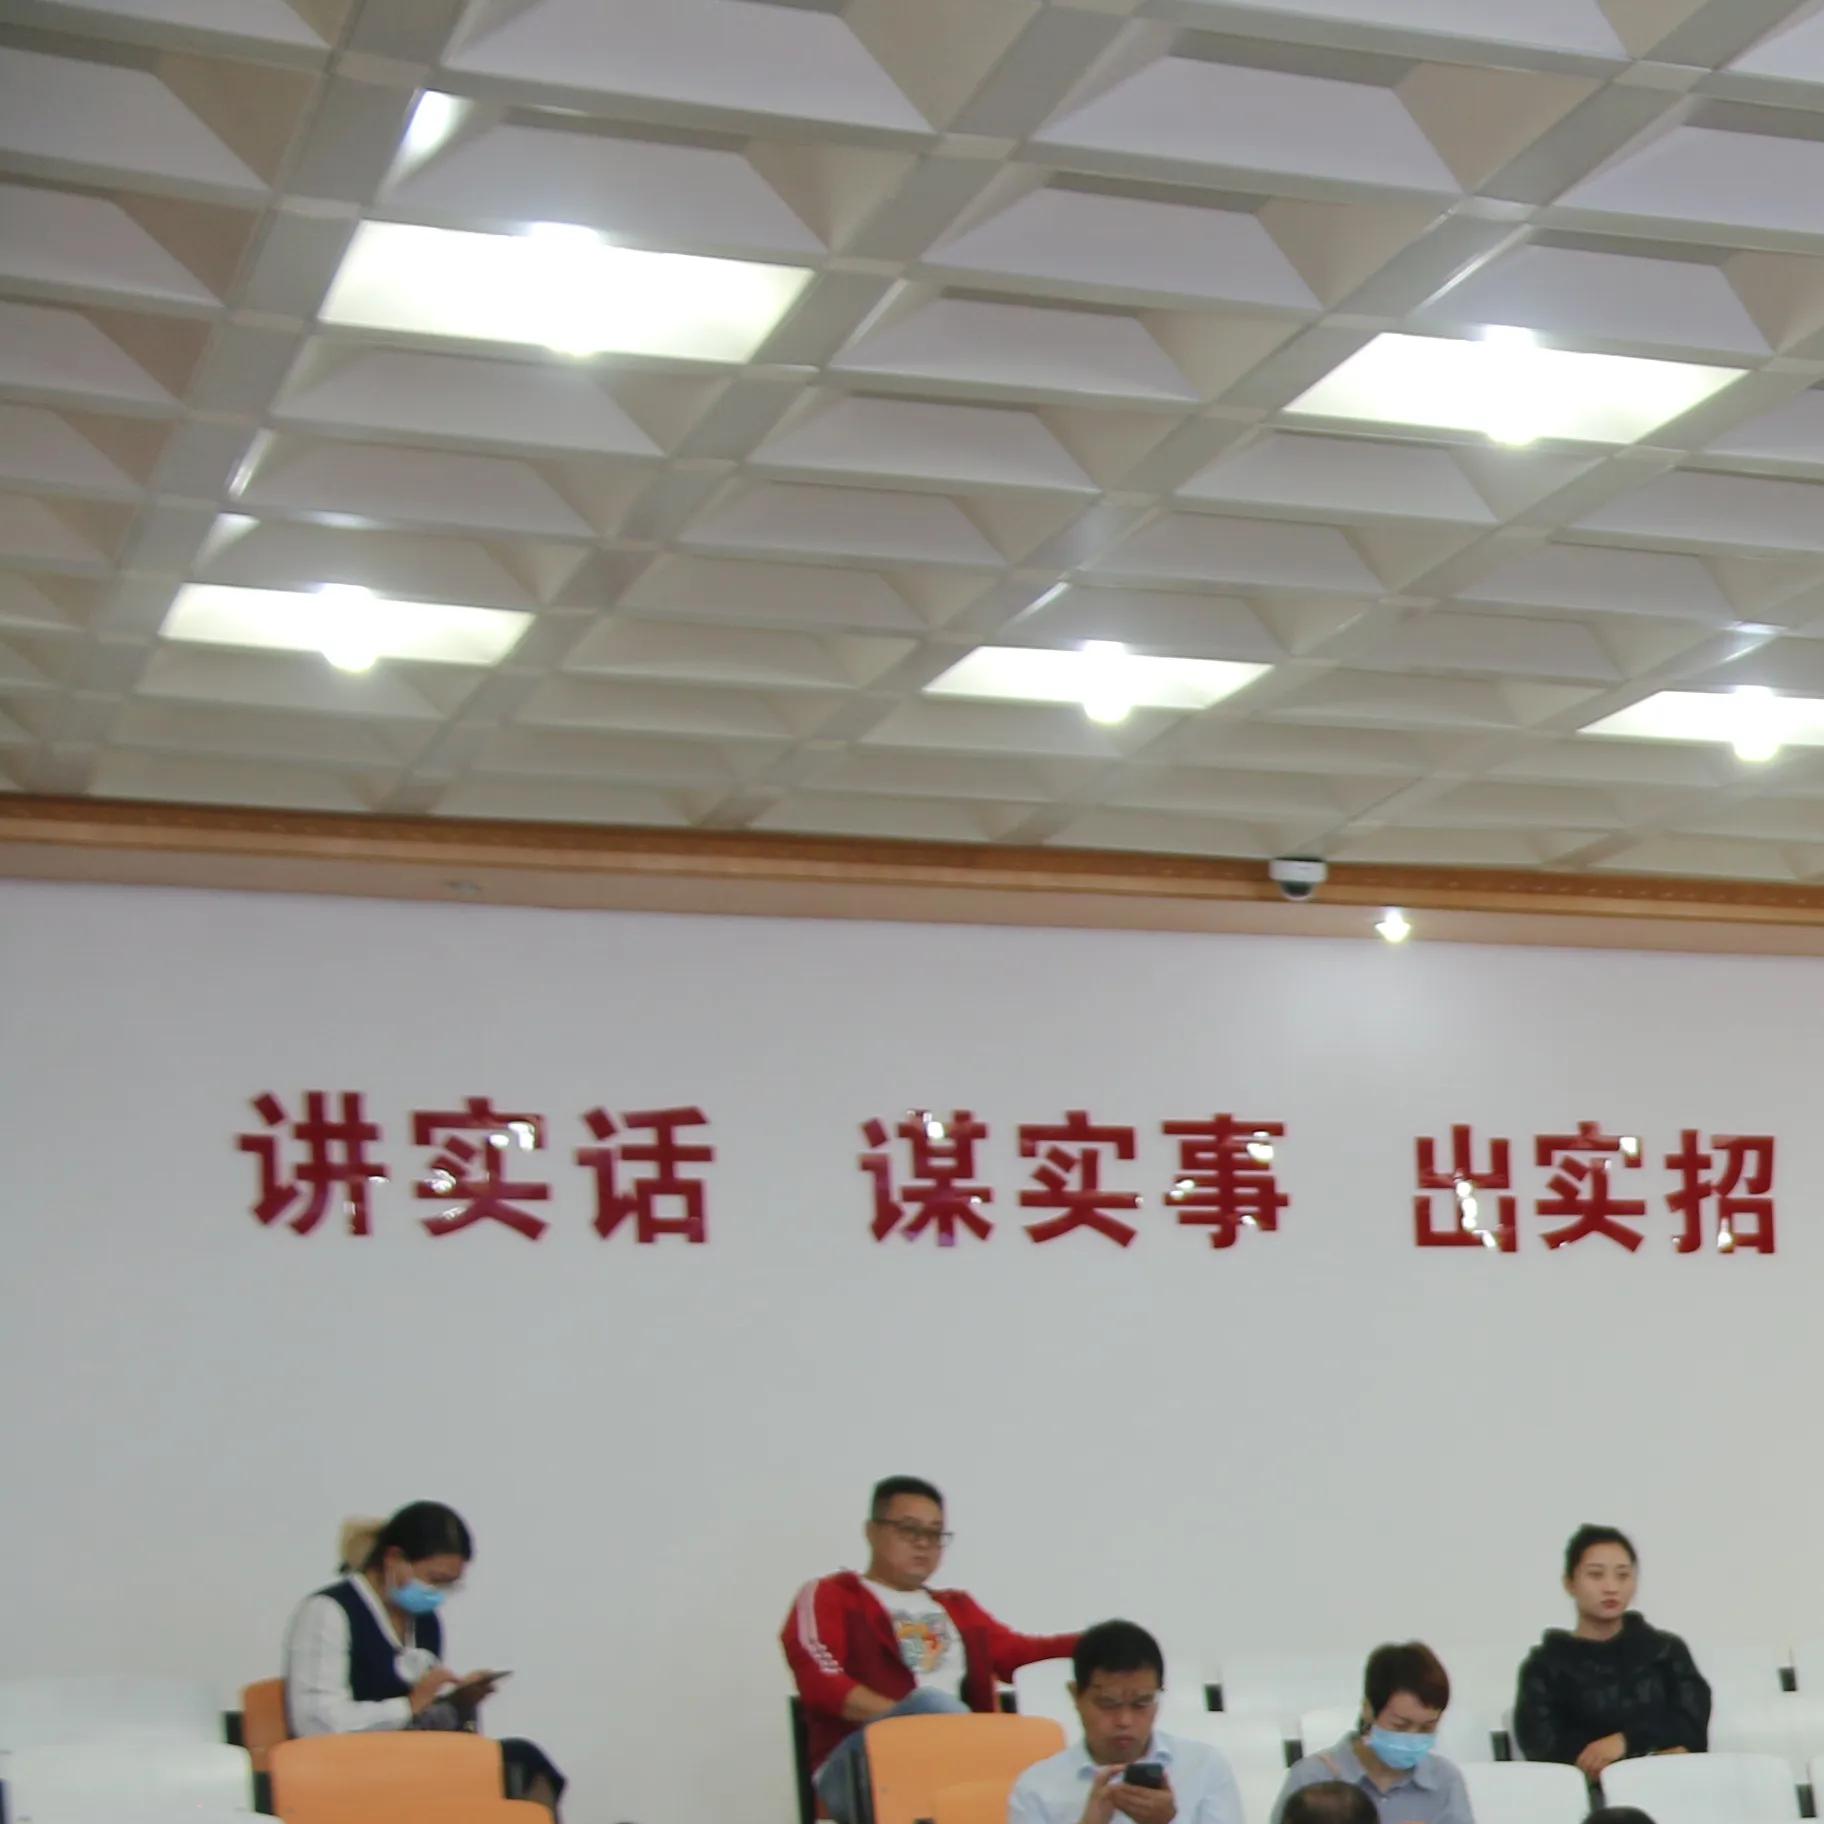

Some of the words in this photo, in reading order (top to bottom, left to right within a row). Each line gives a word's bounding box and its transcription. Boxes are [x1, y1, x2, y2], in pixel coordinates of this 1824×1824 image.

[238, 1092, 713, 1243] 讲实话
[860, 1110, 1290, 1248] 谋实事
[1414, 1121, 1777, 1254] 出实招
